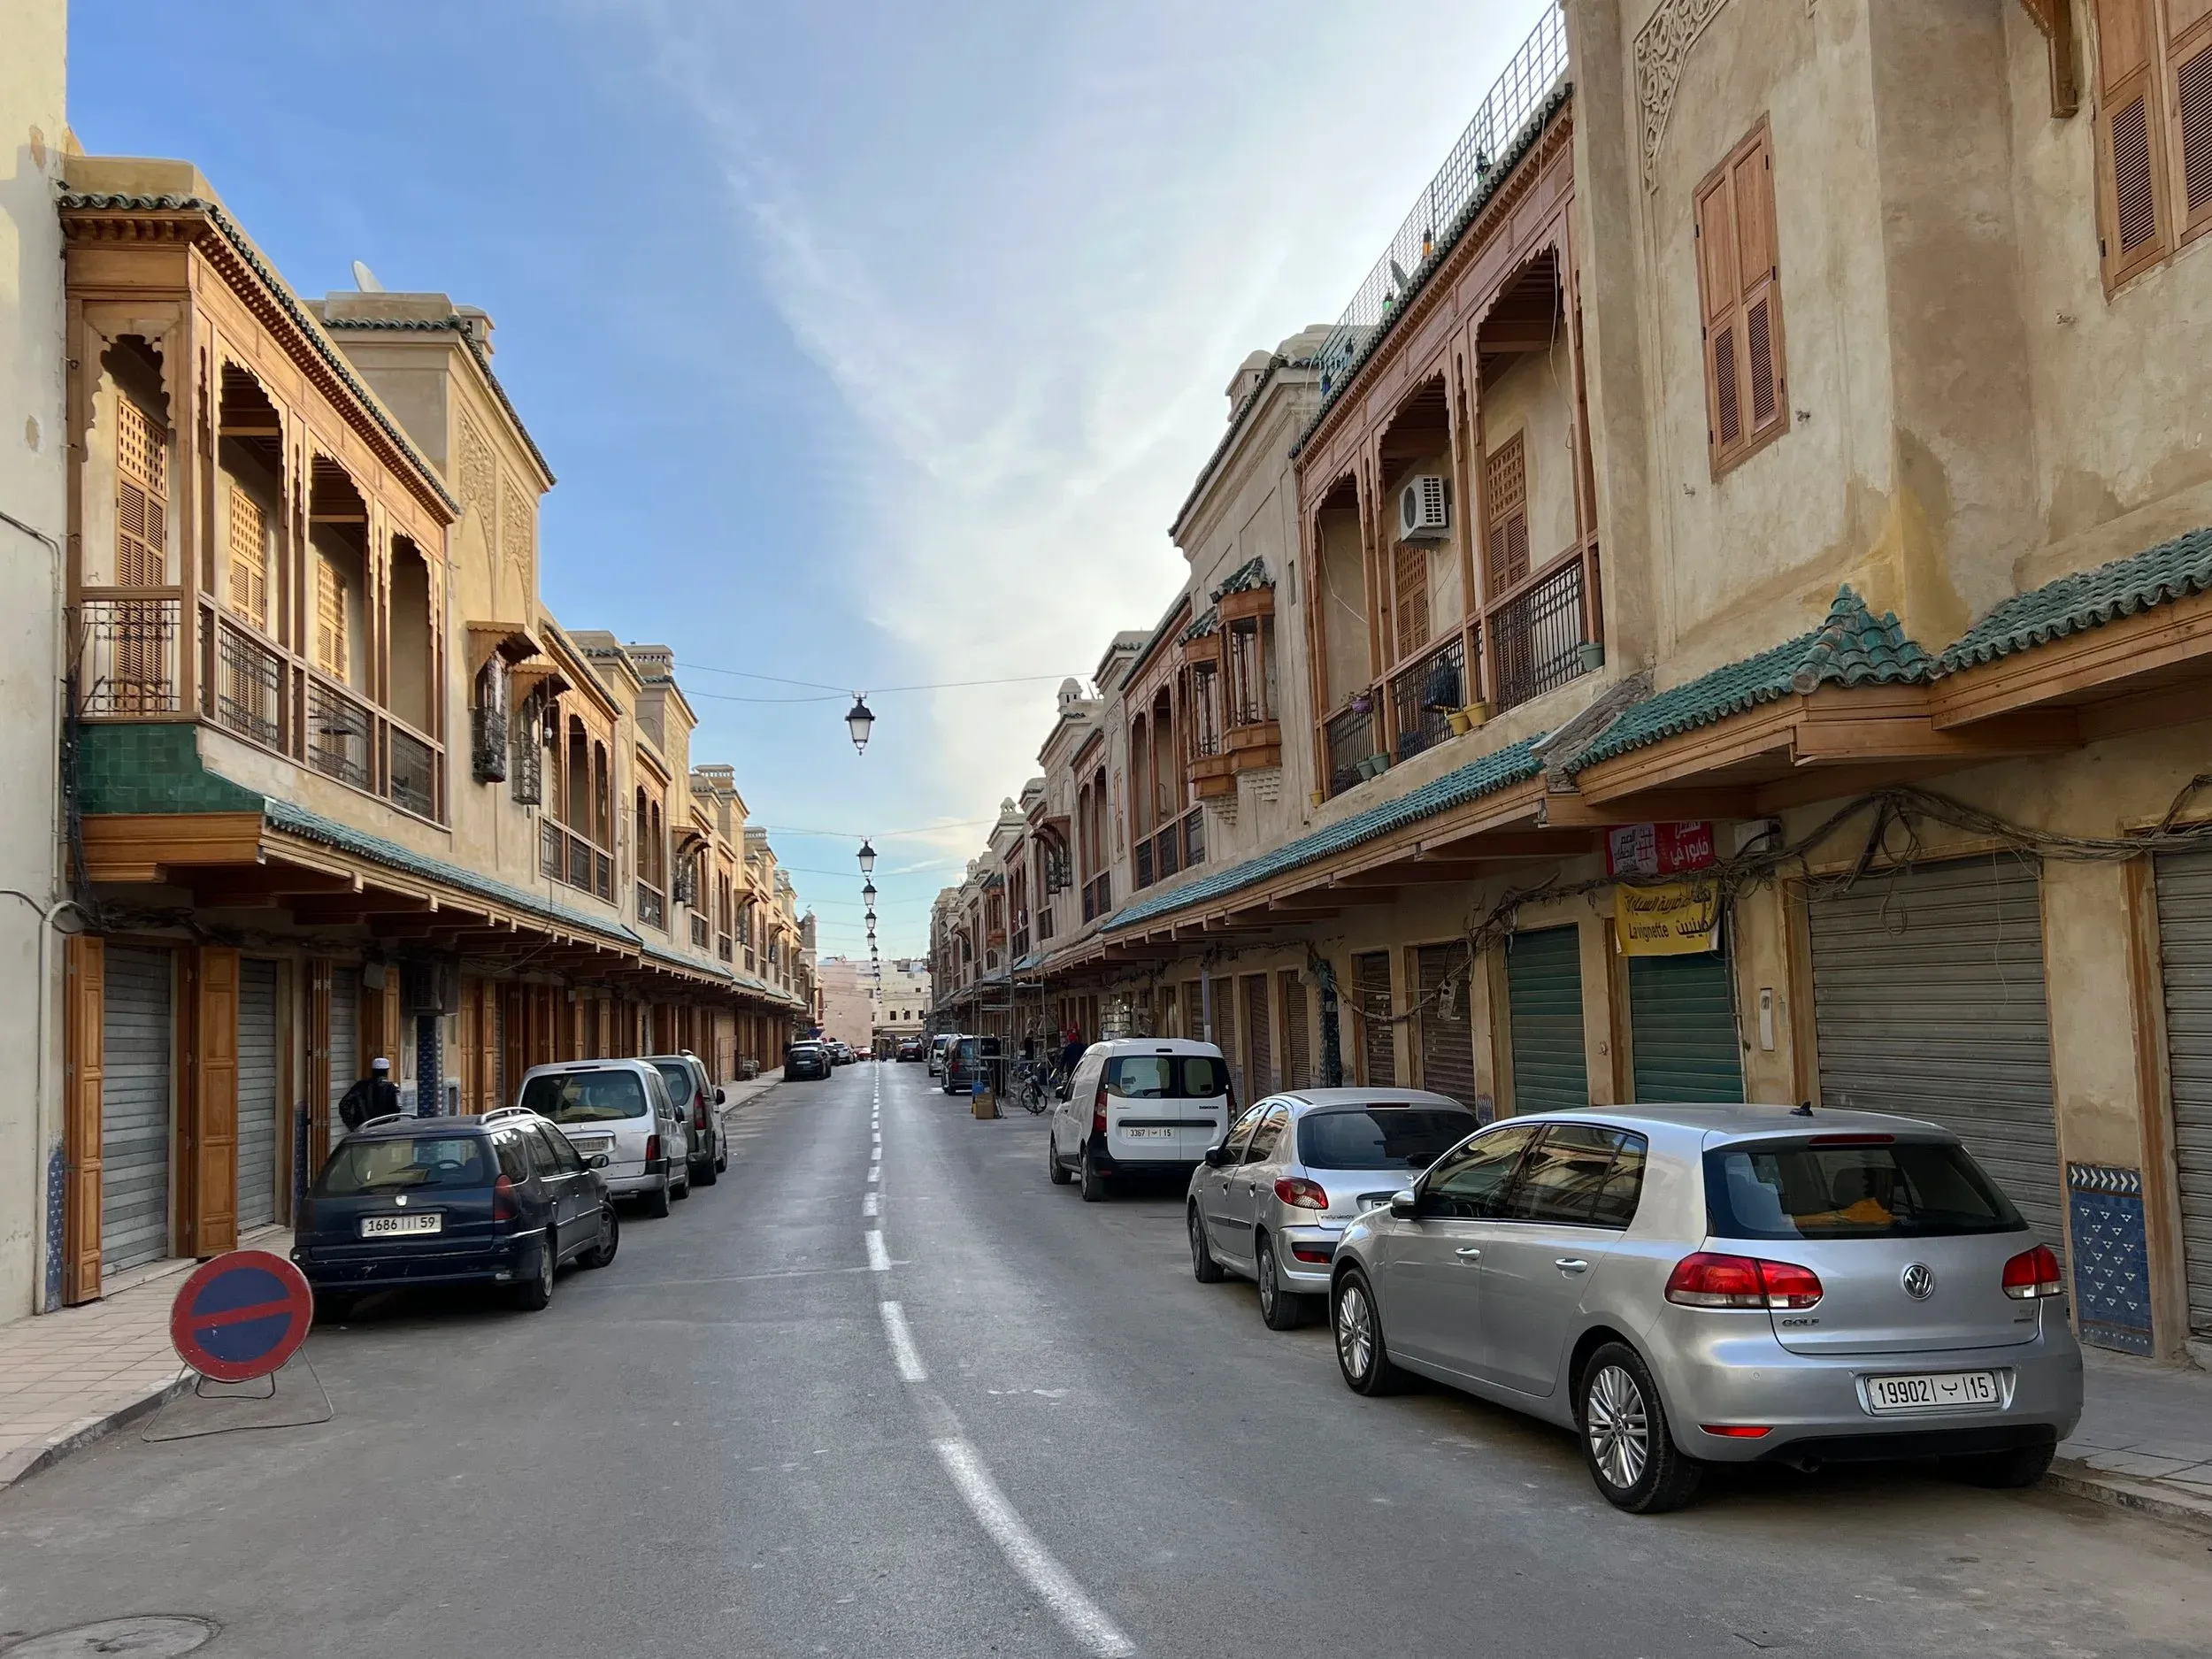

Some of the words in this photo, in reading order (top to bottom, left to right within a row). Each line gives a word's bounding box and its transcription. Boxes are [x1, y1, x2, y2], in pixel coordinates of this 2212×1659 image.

[368, 1219, 397, 1232] 1686
[420, 1217, 434, 1228] 59
[1781, 1317, 1820, 1327] GOLF
[1878, 1379, 1930, 1404] 19902
[1941, 1382, 1958, 1396] ب
[1970, 1377, 1989, 1399] 15
